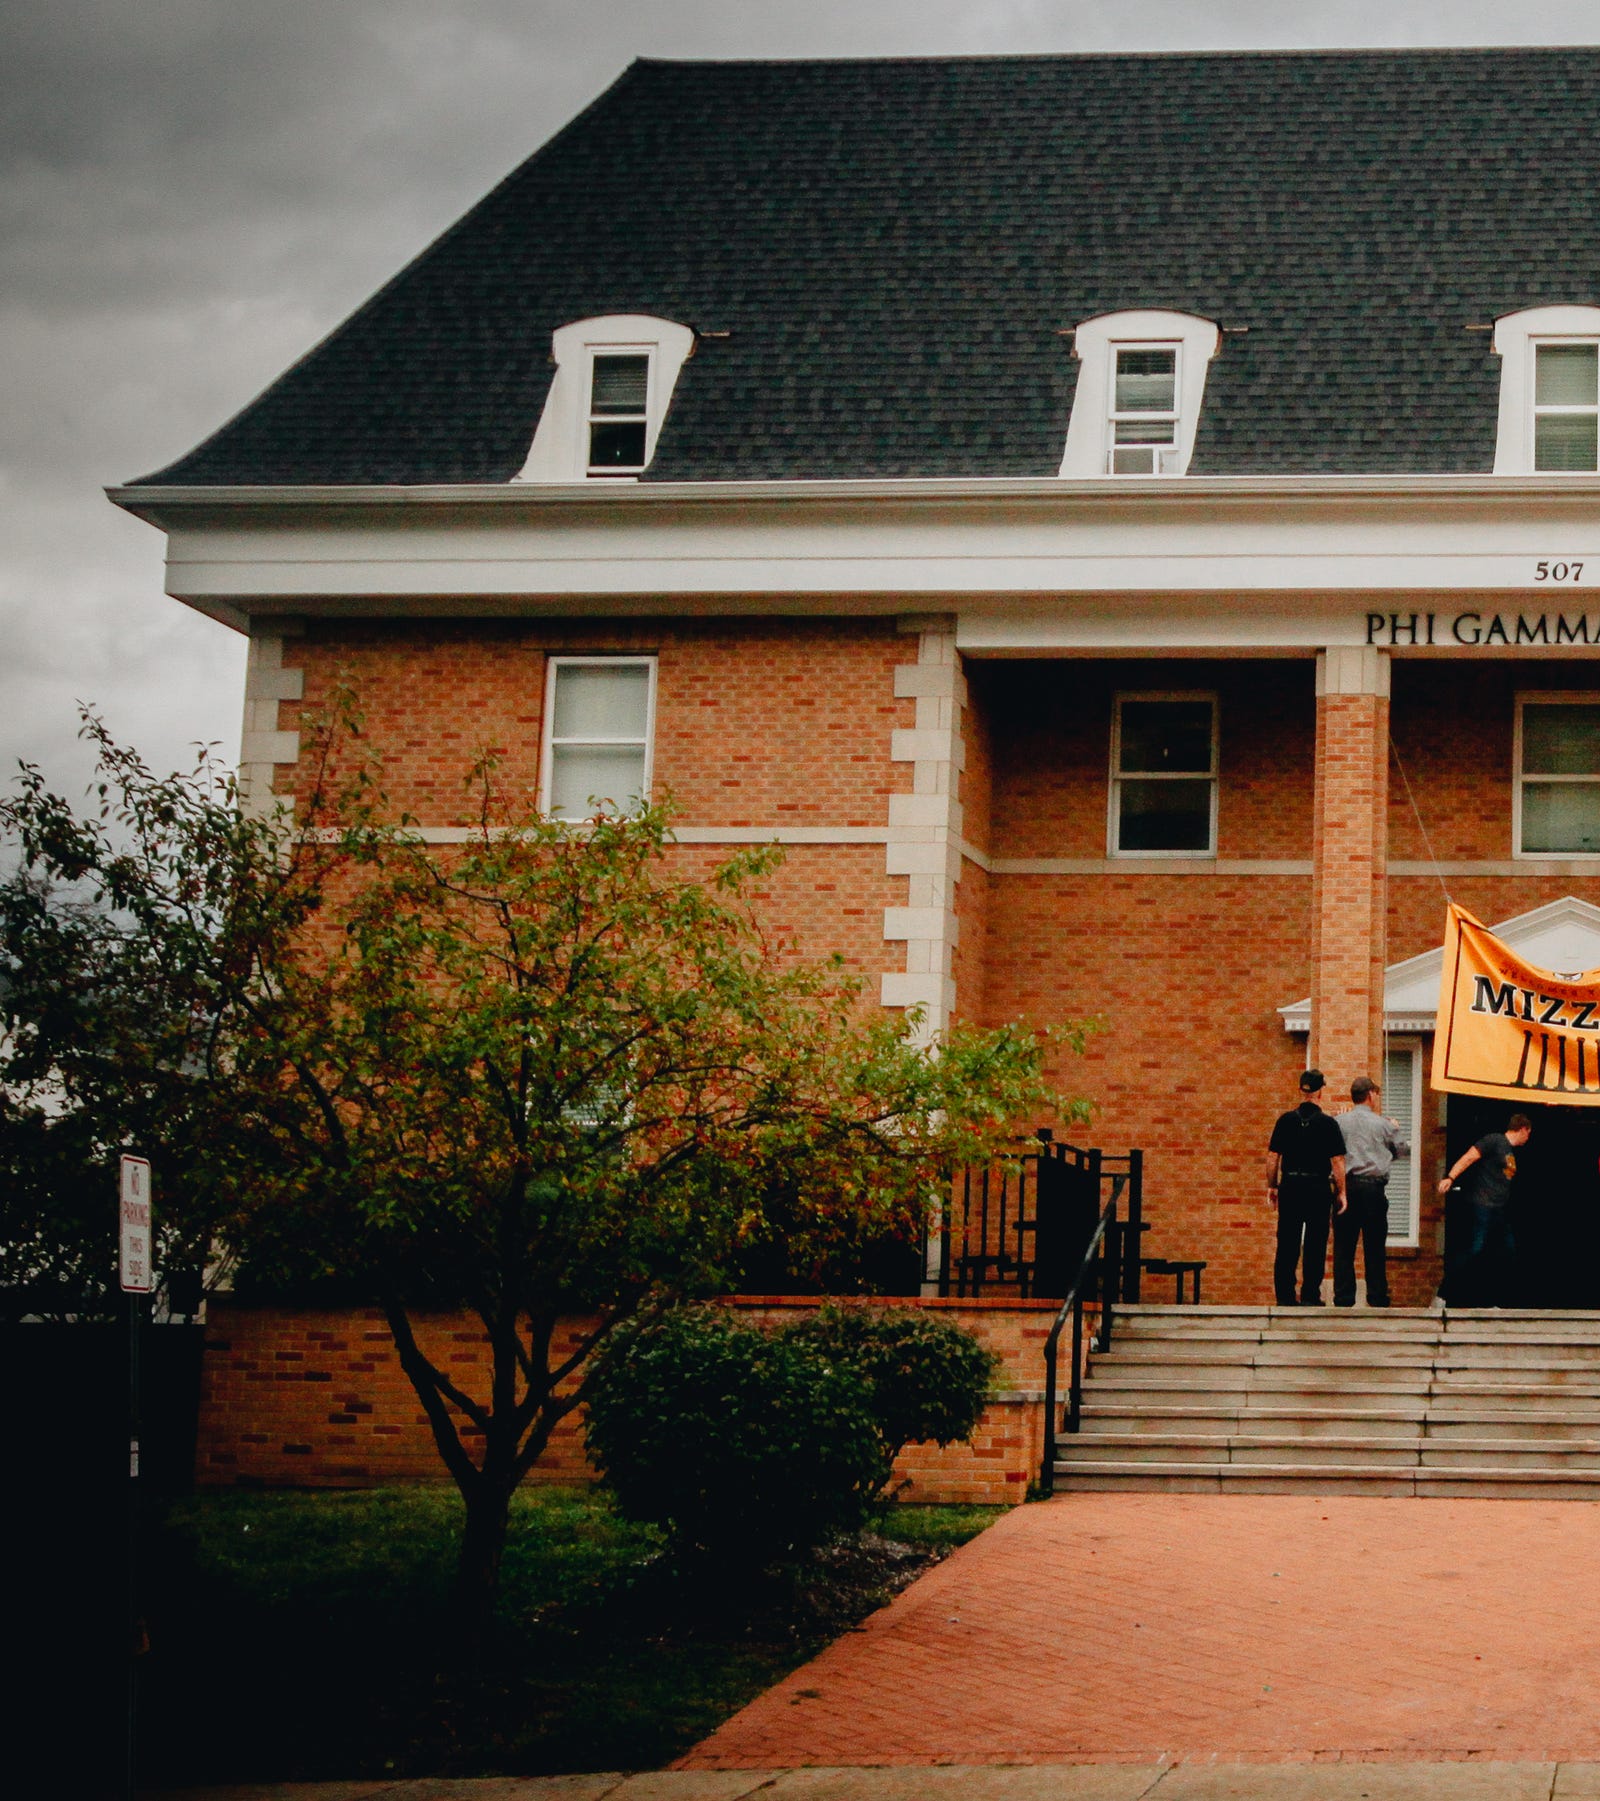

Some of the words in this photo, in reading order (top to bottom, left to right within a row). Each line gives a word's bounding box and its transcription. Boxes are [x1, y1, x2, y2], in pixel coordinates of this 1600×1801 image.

[1534, 561, 1584, 581] 507
[1366, 612, 1436, 645] PHI
[123, 1200, 149, 1227] PARKING
